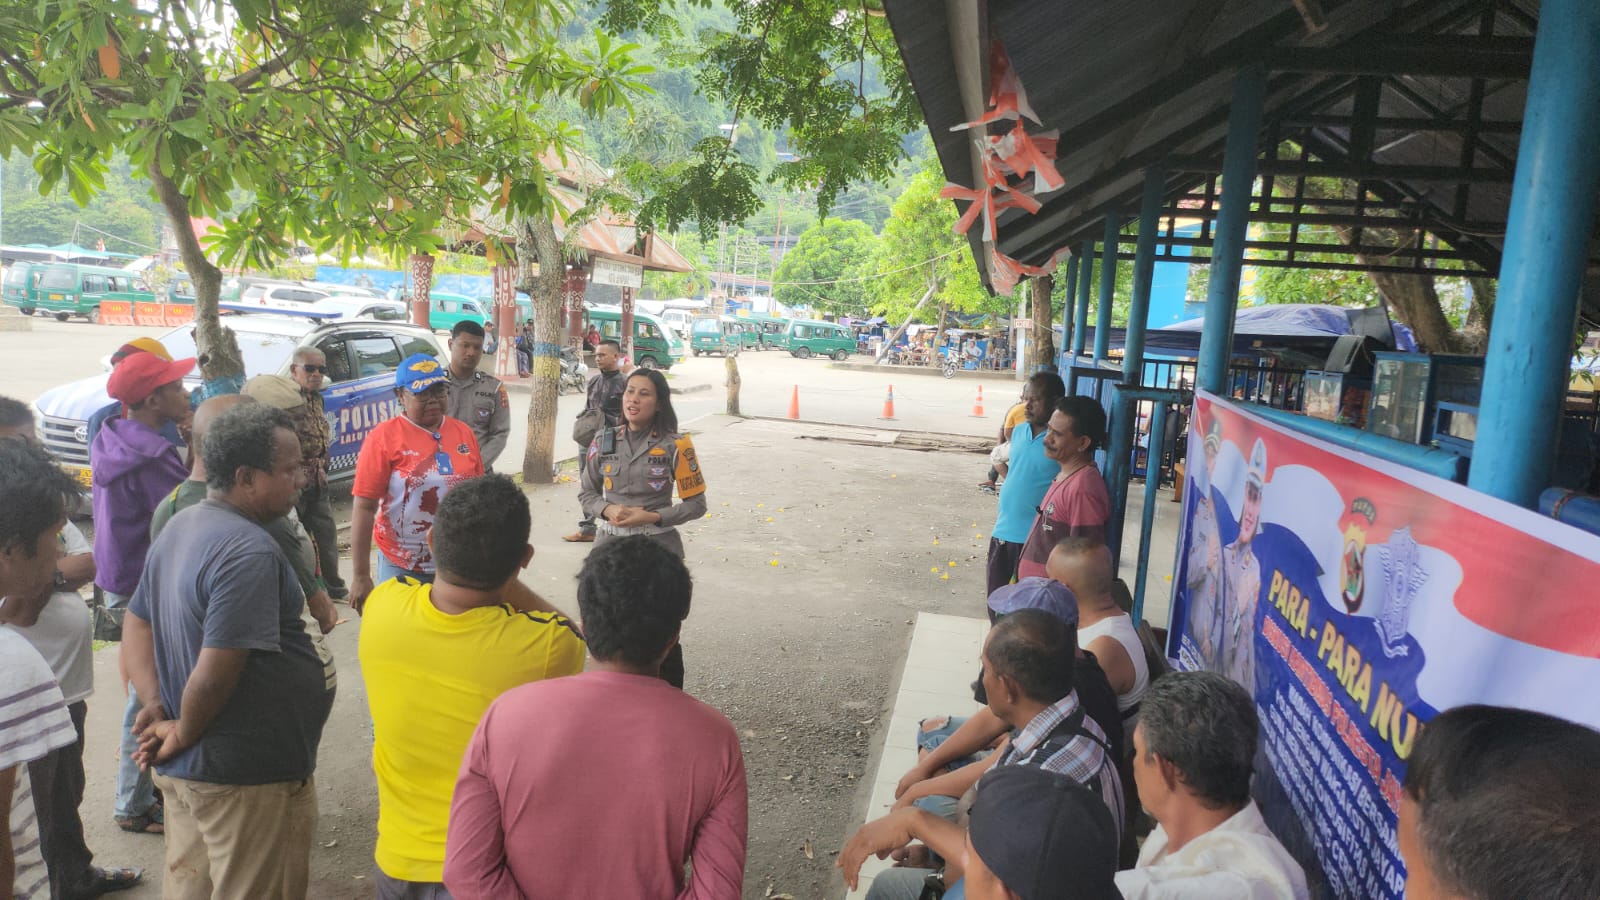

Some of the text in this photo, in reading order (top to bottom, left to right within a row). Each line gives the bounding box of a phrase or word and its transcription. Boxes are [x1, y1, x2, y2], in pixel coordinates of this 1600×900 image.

[341, 431, 364, 445] LALU
[1267, 569, 1311, 639] PARA
[1317, 620, 1374, 714] PARA
[1369, 681, 1424, 761] NU
